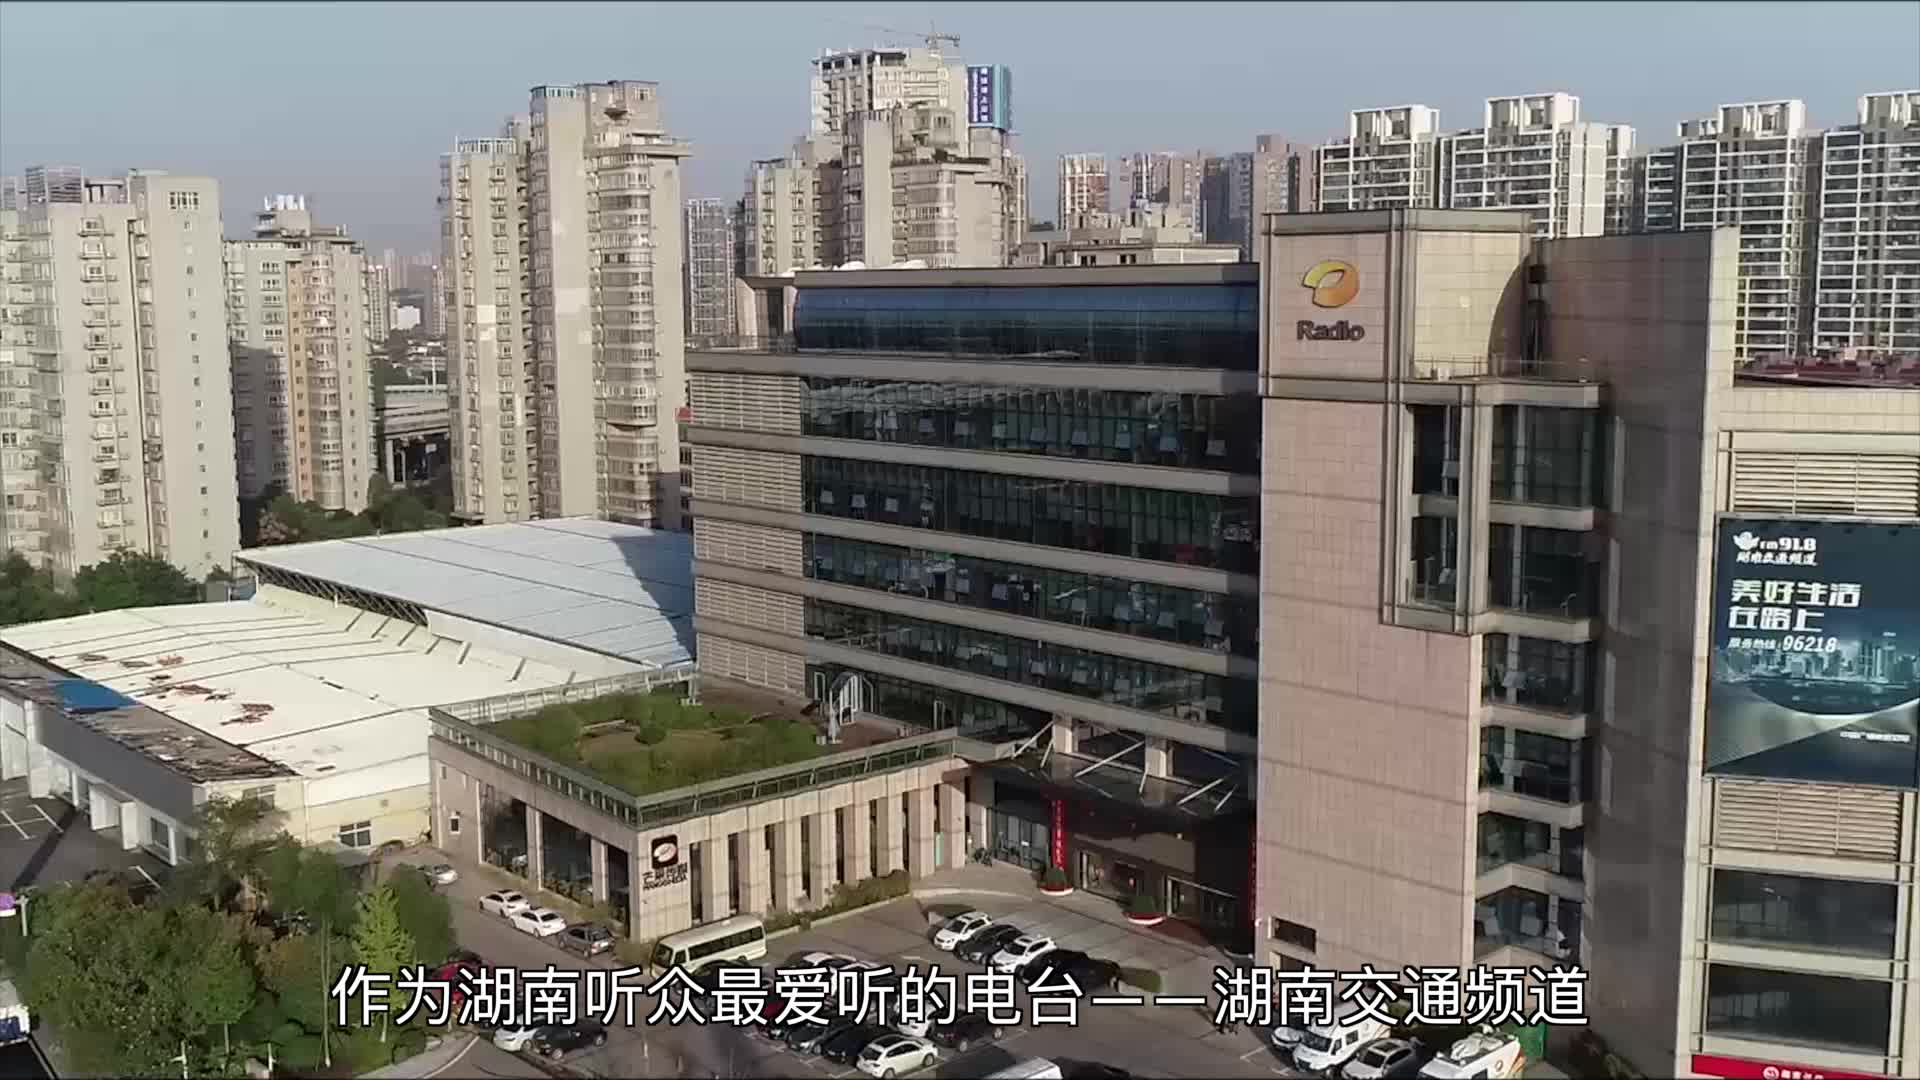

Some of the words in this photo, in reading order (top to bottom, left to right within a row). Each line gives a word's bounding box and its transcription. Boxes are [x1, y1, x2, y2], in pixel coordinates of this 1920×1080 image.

[1296, 320, 1365, 341] Radio
[1731, 579, 1862, 608] 美好生活
[1728, 606, 1825, 632] 在路上
[1782, 635, 1838, 653] 96218
